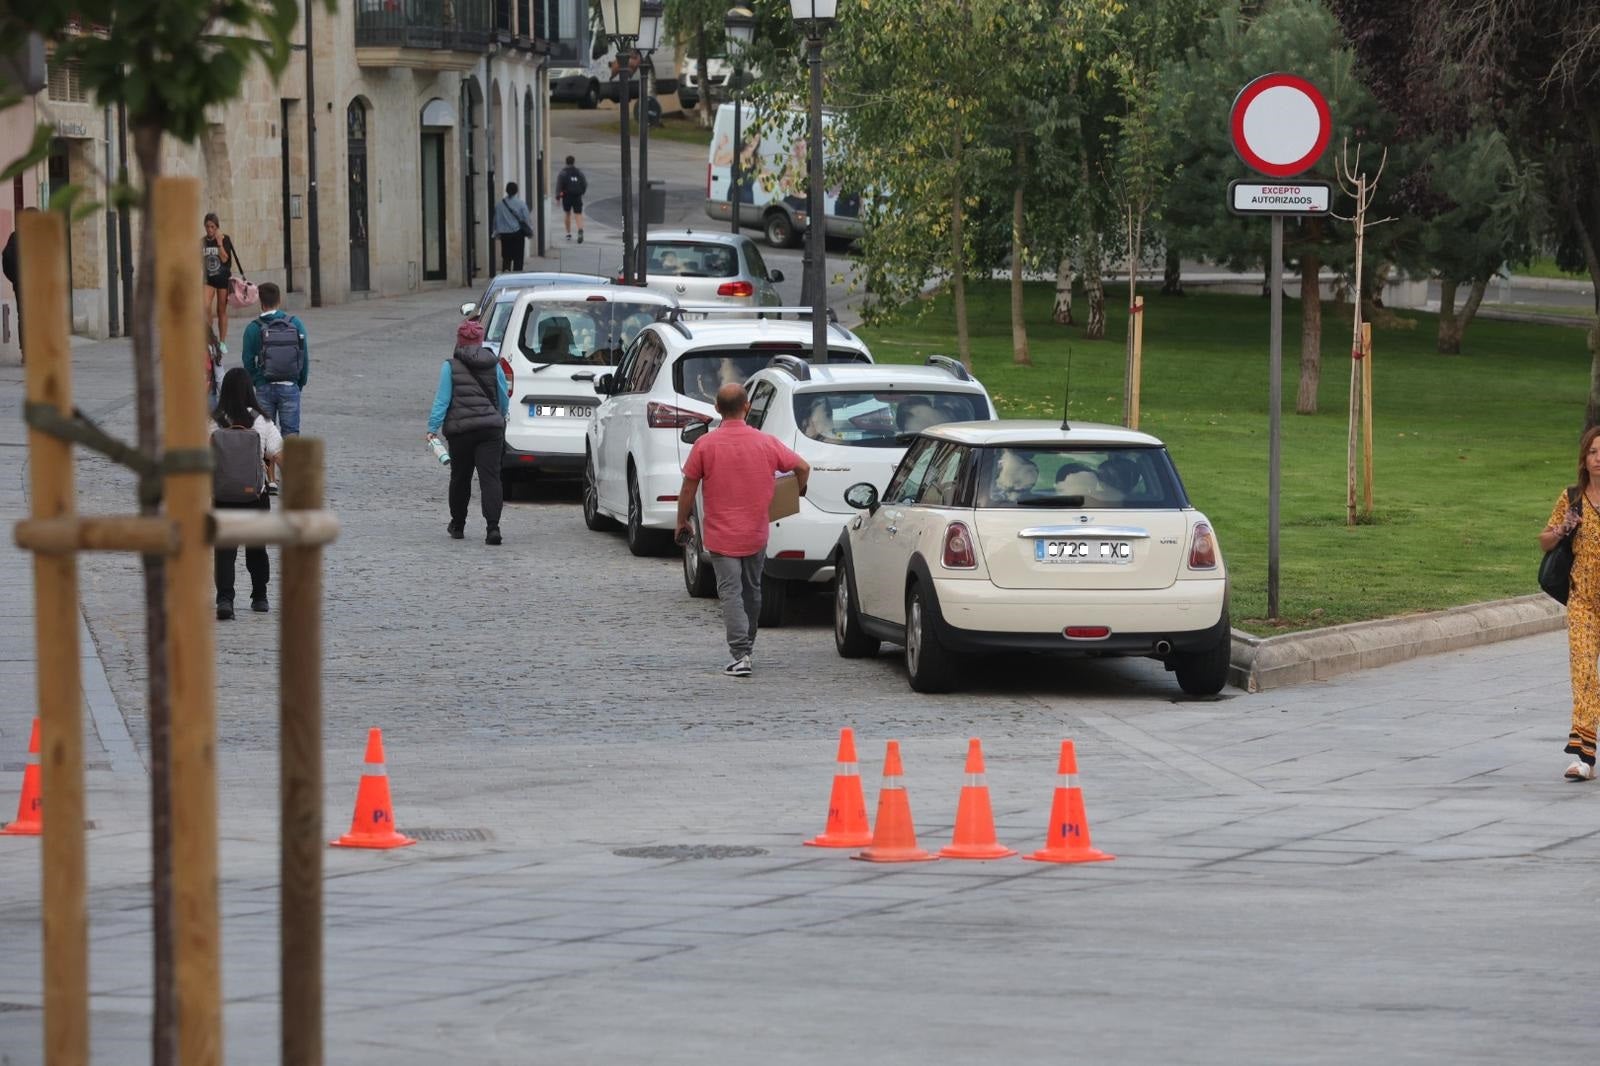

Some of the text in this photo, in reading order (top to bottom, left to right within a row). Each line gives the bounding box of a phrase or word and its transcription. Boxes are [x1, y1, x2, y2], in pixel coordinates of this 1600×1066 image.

[1251, 196, 1312, 204] AUTORIZADOS
[536, 405, 592, 417] 87 KDG
